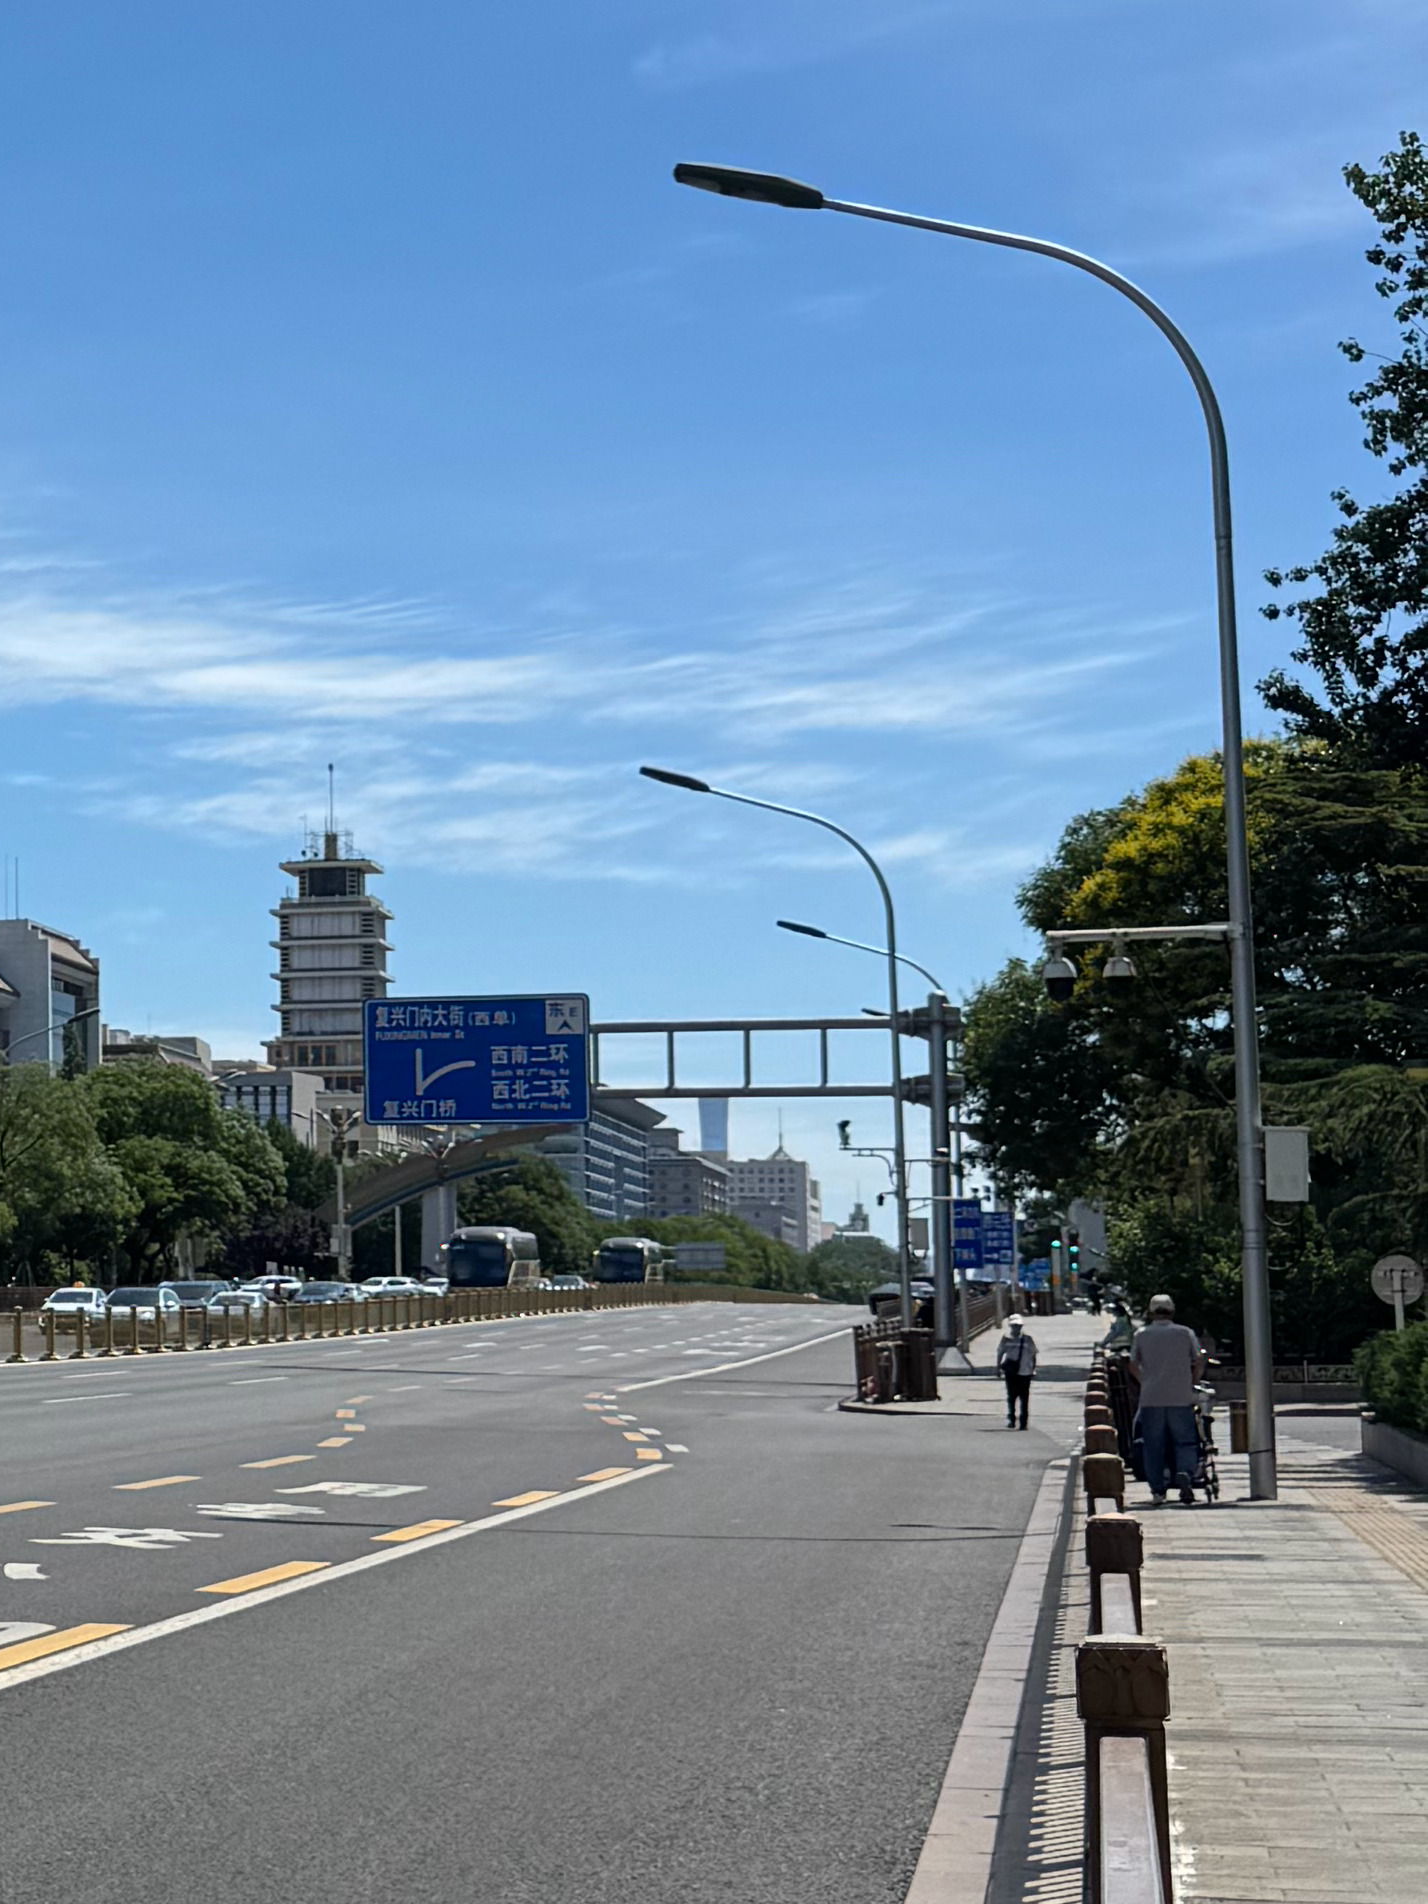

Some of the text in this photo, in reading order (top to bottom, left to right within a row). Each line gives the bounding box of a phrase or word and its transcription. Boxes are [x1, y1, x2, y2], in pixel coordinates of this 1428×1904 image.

[547, 1002, 577, 1018] 东 E
[490, 1044, 569, 1064] 西南二环
[491, 1080, 570, 1100] 西北二环
[383, 1099, 457, 1118] 复兴门桥
